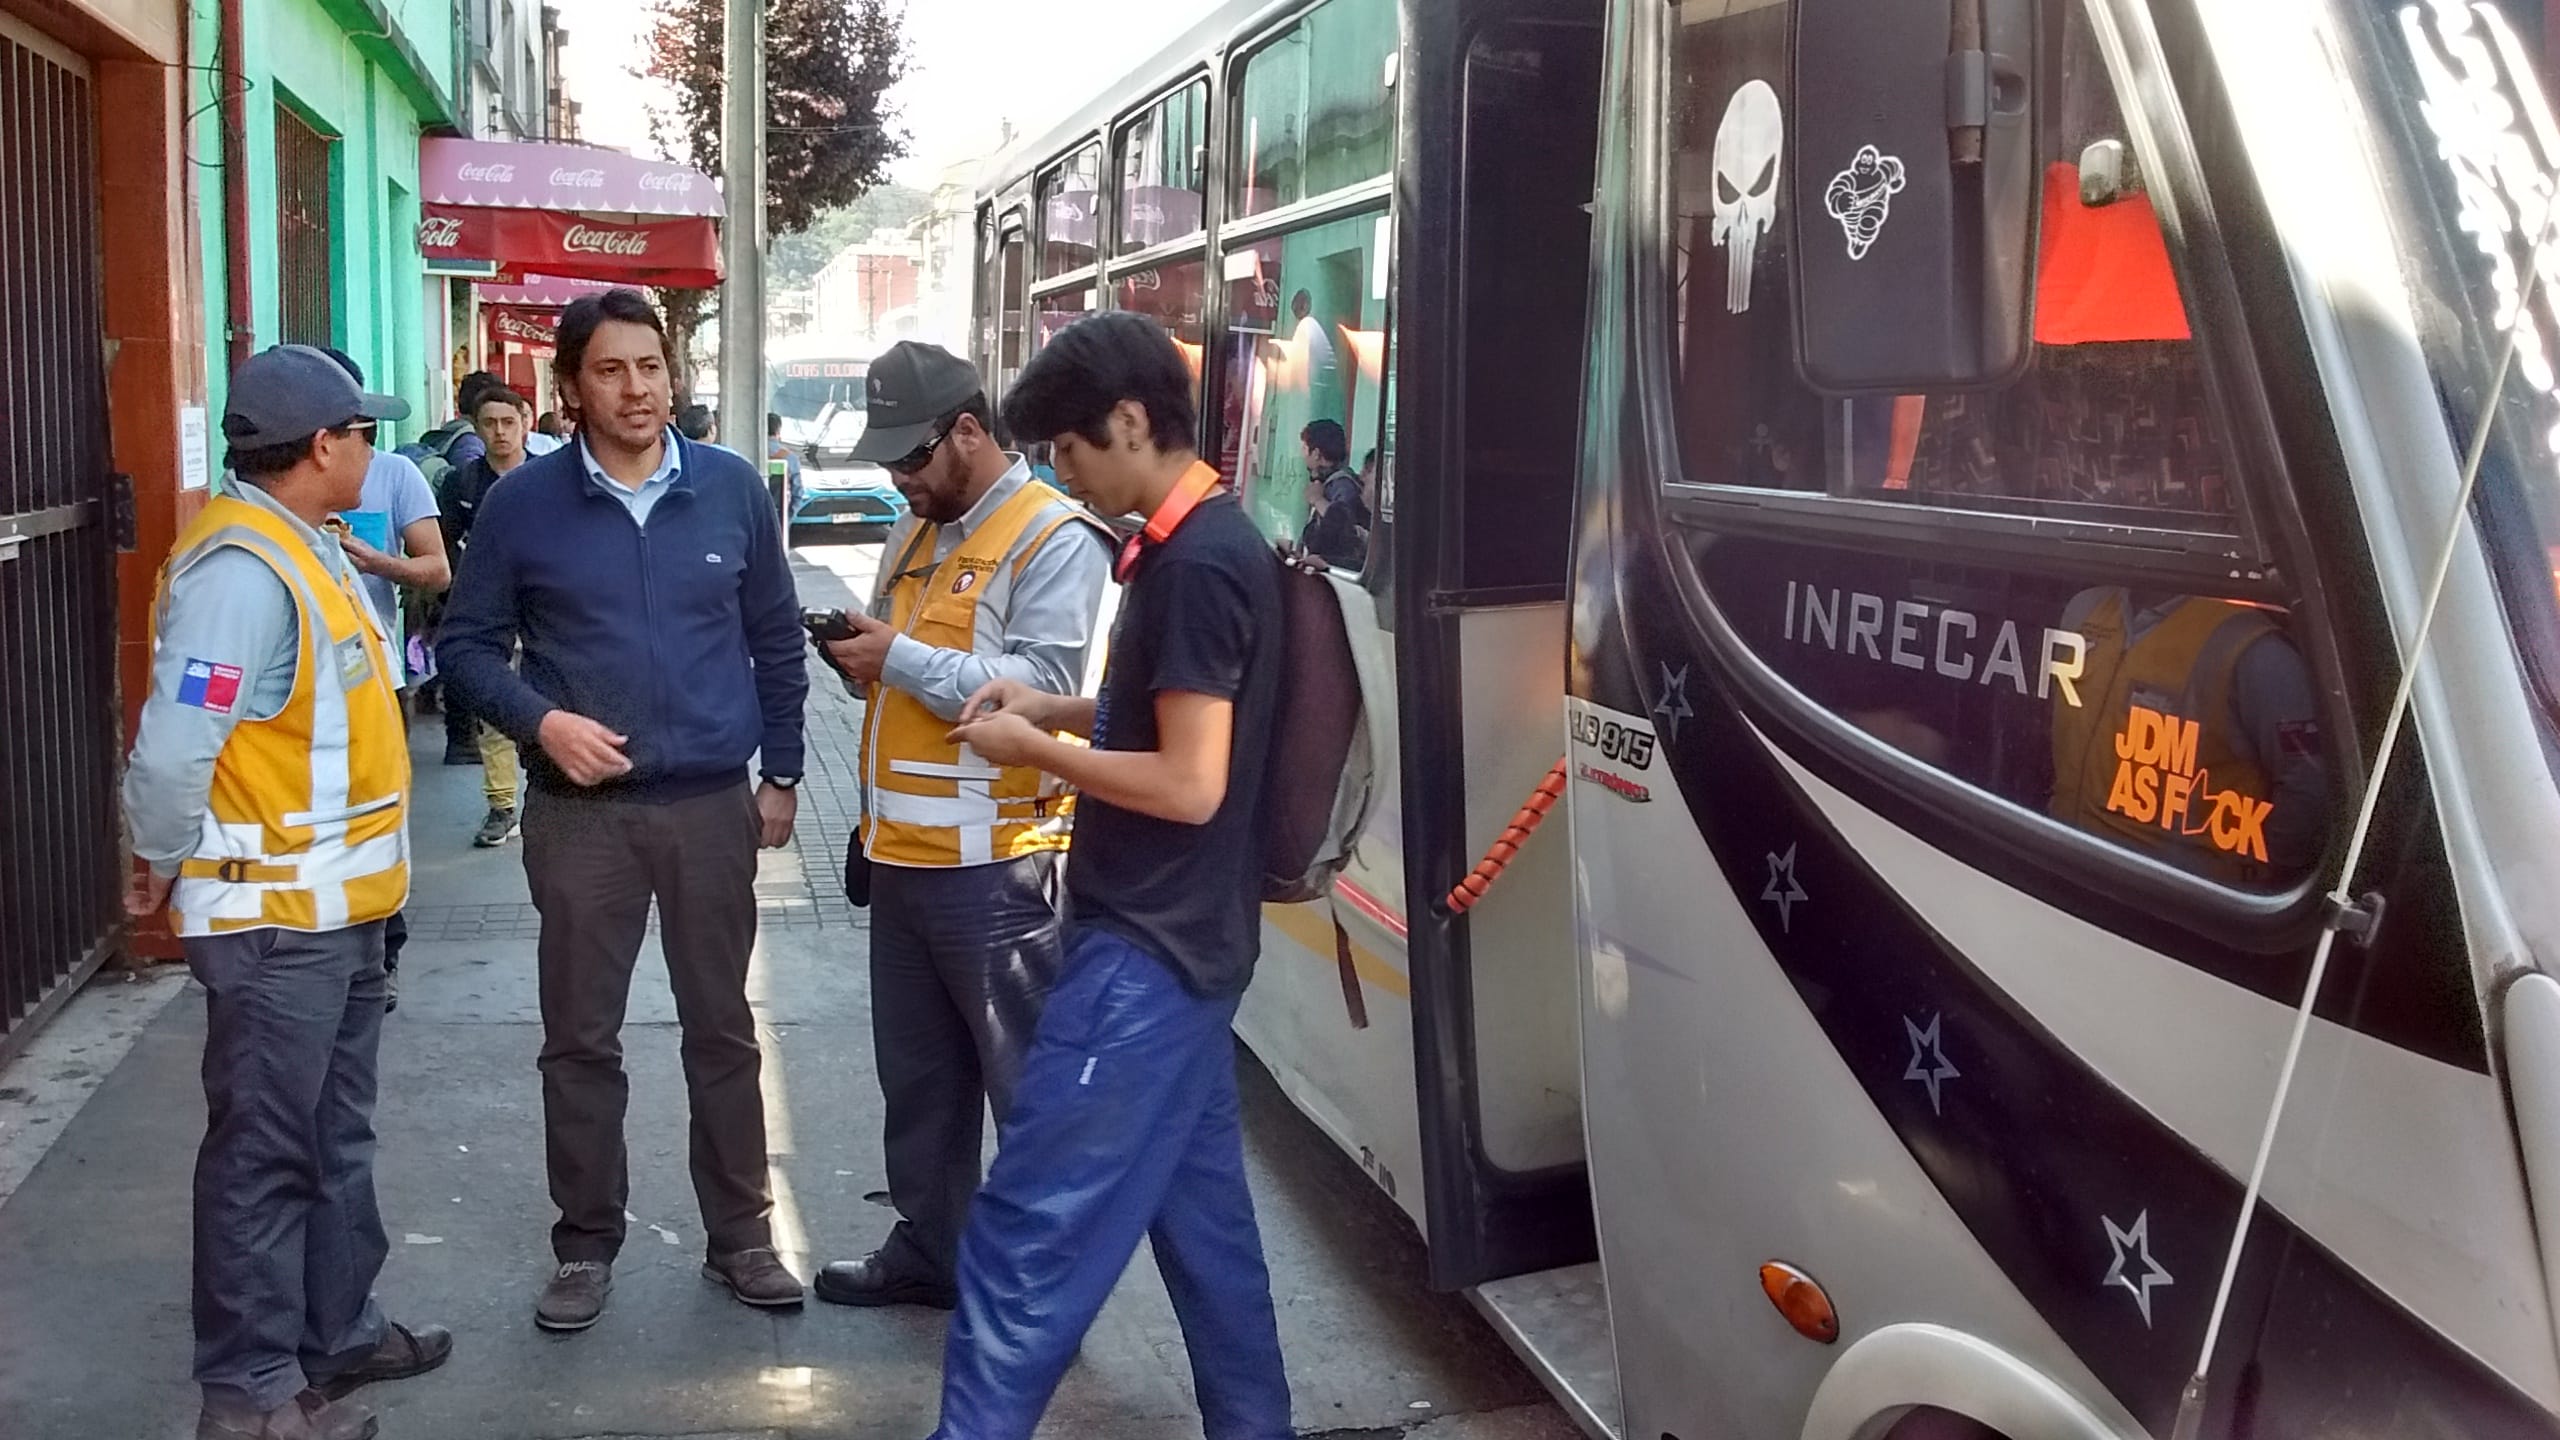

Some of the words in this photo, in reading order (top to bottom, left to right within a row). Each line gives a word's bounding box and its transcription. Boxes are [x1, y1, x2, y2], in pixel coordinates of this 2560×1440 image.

[563, 224, 650, 255] Coca-Cola
[1784, 581, 2082, 707] INRECAR
[1601, 721, 1656, 770] 915
[2115, 706, 2199, 777] JDM
[2106, 760, 2158, 823] AS
[2161, 768, 2274, 863] FCK
